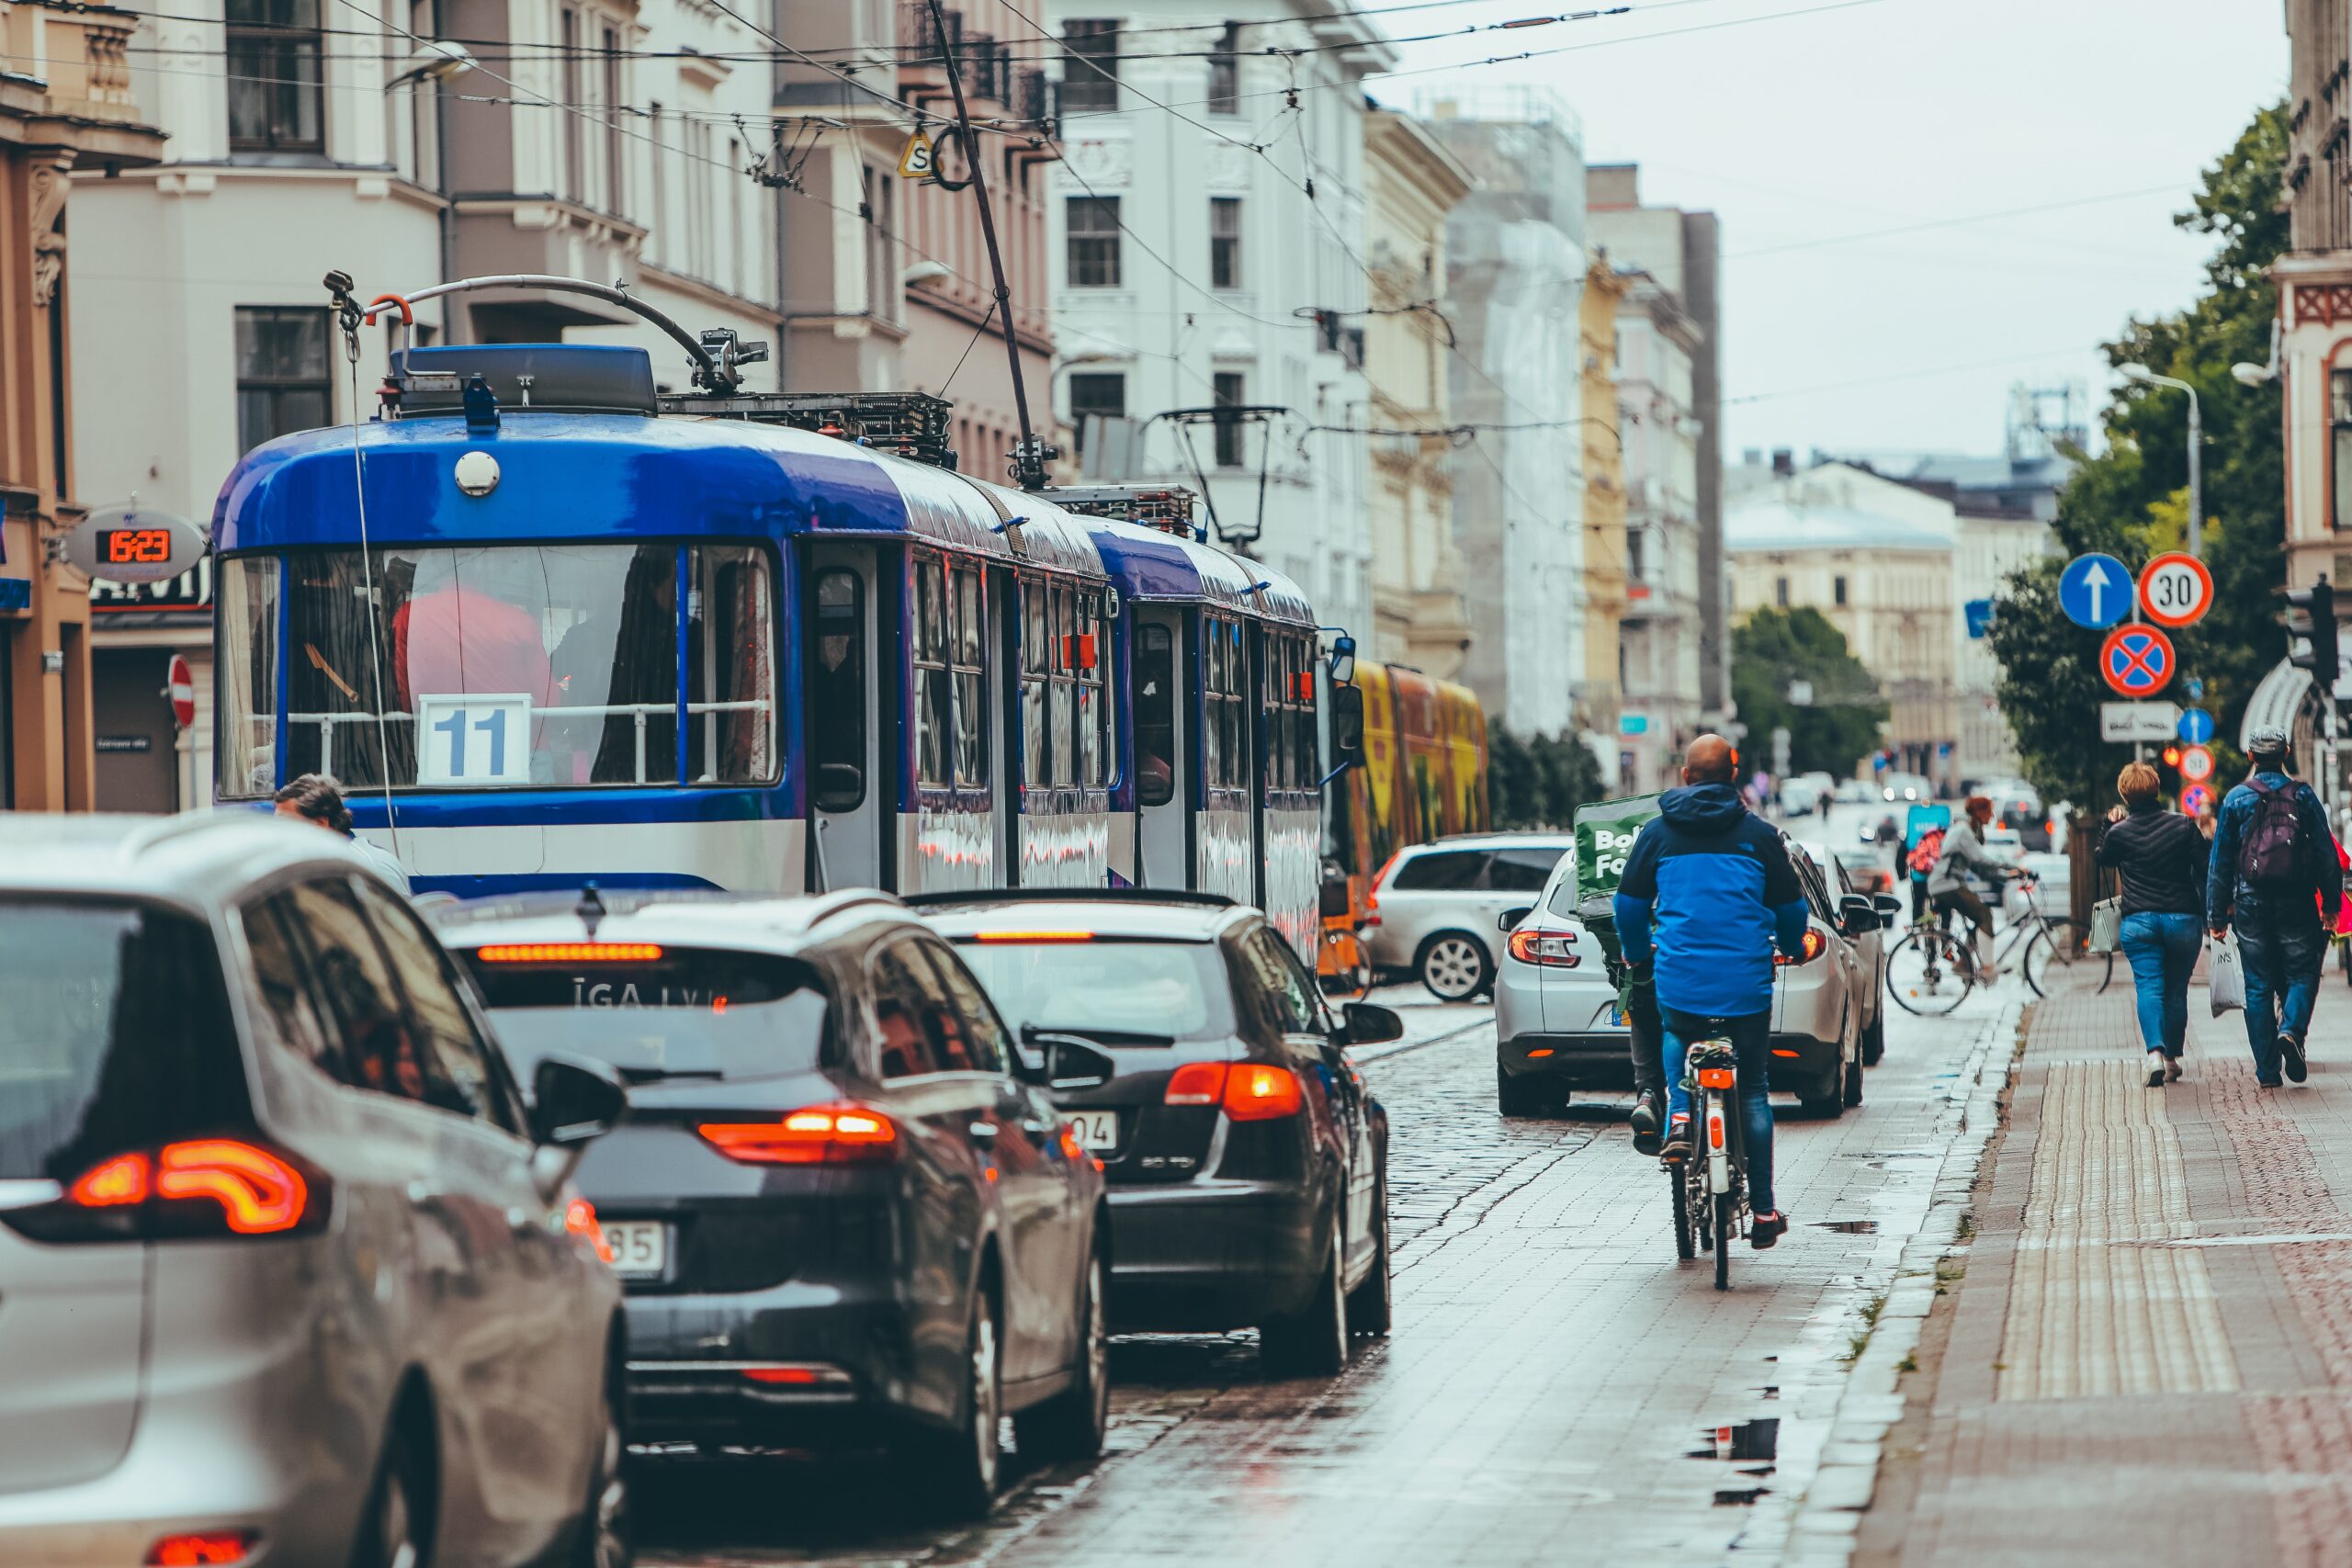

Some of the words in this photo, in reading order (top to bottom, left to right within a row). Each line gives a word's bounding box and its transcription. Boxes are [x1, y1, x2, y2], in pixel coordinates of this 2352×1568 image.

[912, 146, 928, 170] S
[2159, 574, 2191, 606] 30
[434, 708, 506, 777] 11
[1594, 825, 1644, 852] Bol
